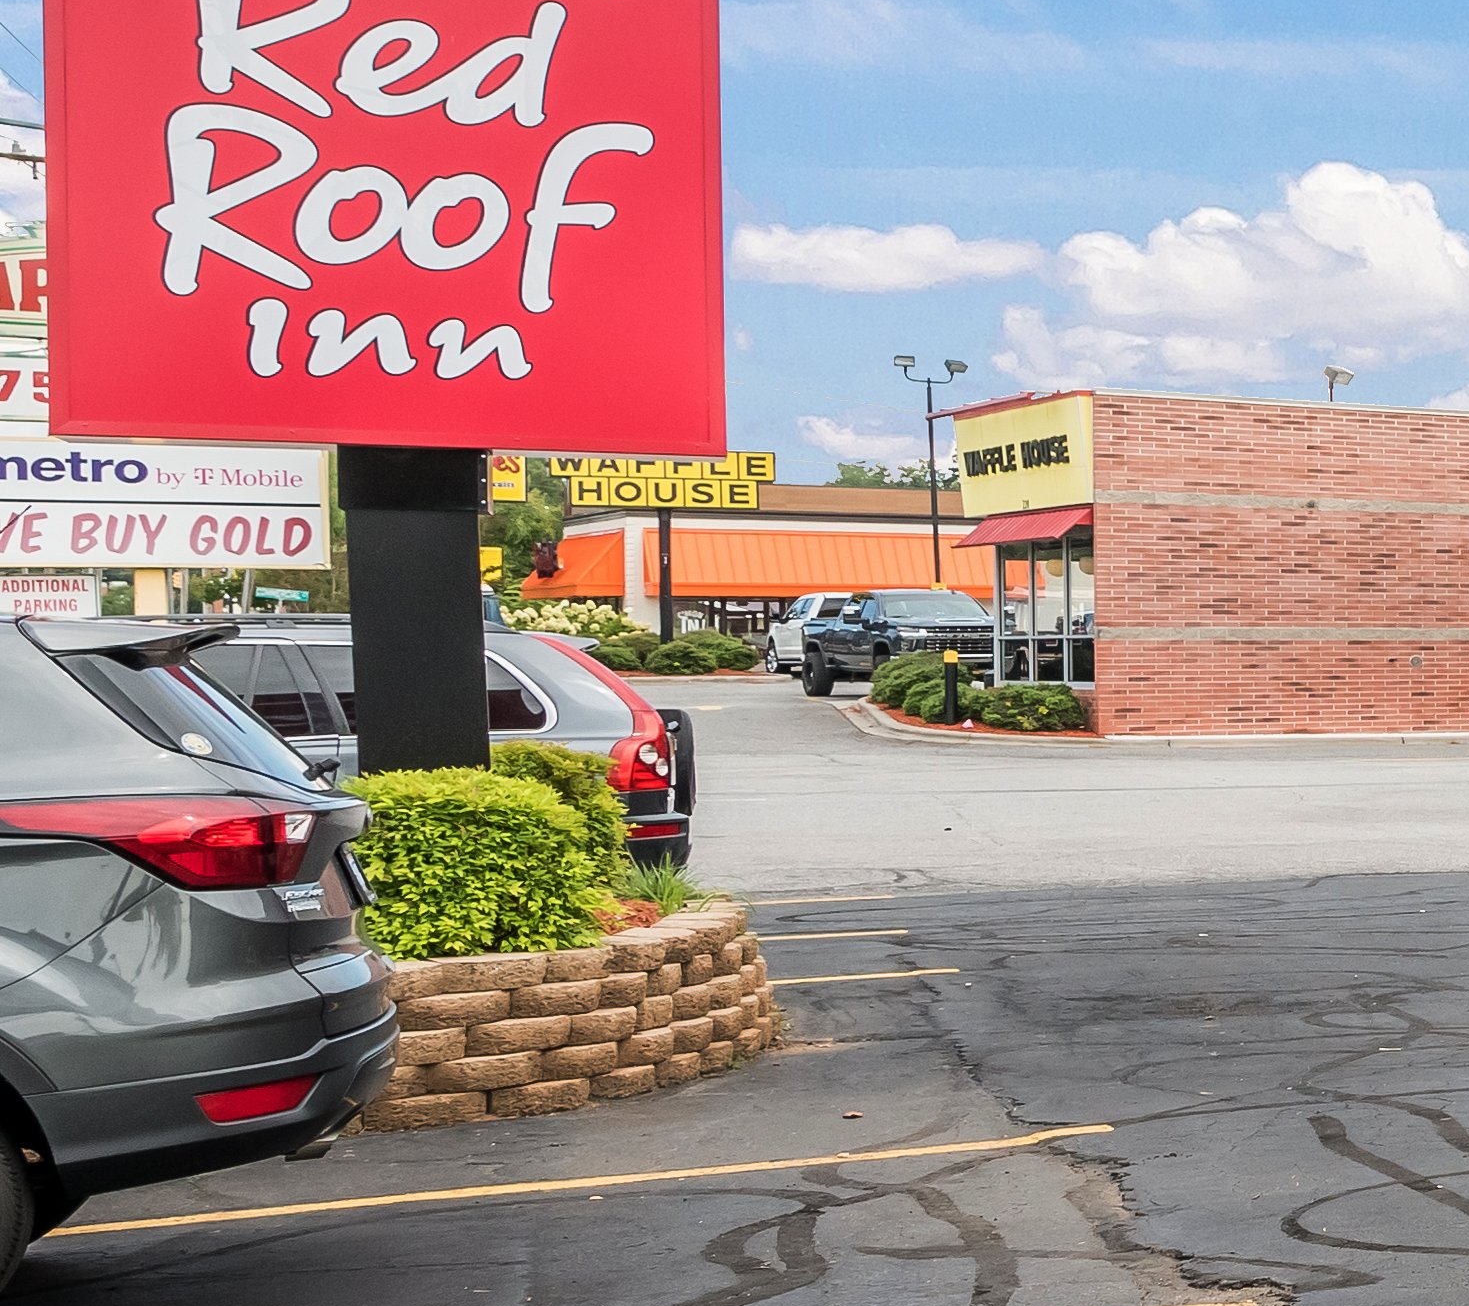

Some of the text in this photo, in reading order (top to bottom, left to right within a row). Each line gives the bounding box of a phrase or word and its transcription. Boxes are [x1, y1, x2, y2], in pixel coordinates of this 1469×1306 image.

[153, 104, 655, 313] Roof
[1020, 434, 1070, 469] HOUSE
[0, 451, 148, 483] metro
[155, 467, 186, 490] by
[578, 481, 750, 503] HOUSE
[0, 512, 312, 557] E BUY GOLD
[2, 579, 89, 593] ADDITIONAL
[14, 598, 78, 613] PARKING
